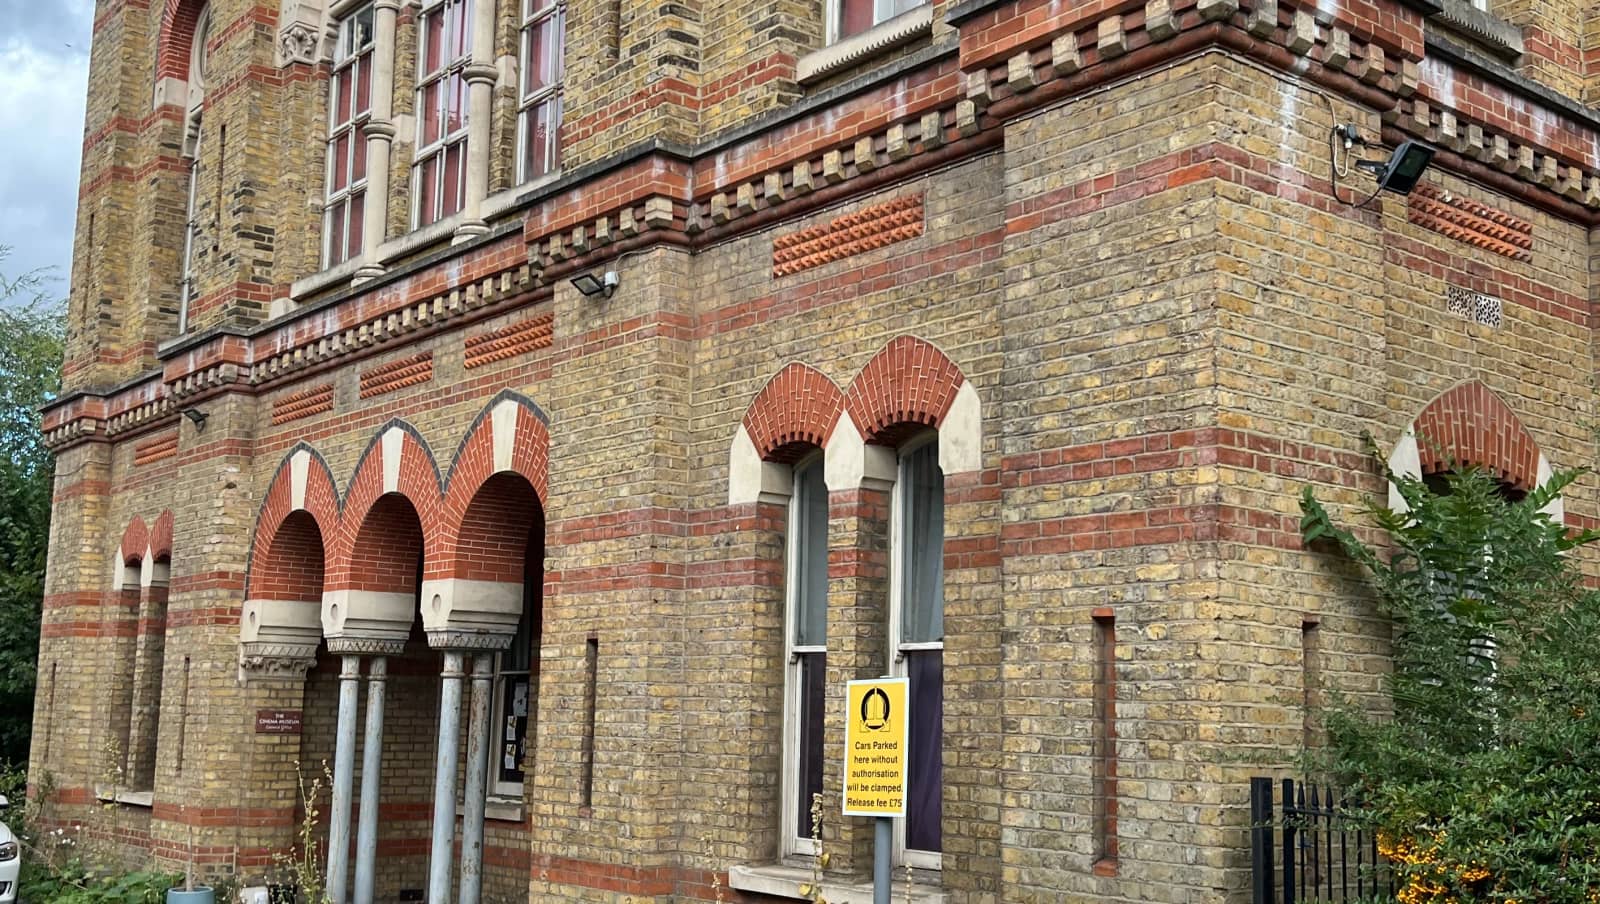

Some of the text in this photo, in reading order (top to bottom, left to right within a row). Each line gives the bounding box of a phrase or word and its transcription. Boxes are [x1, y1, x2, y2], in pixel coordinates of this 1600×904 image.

[855, 741, 898, 750] Cars Parked
[854, 756, 898, 764] here without
[852, 770, 899, 778] authorisation
[871, 784, 903, 793] clamped.
[847, 798, 902, 807] Release fee £75
